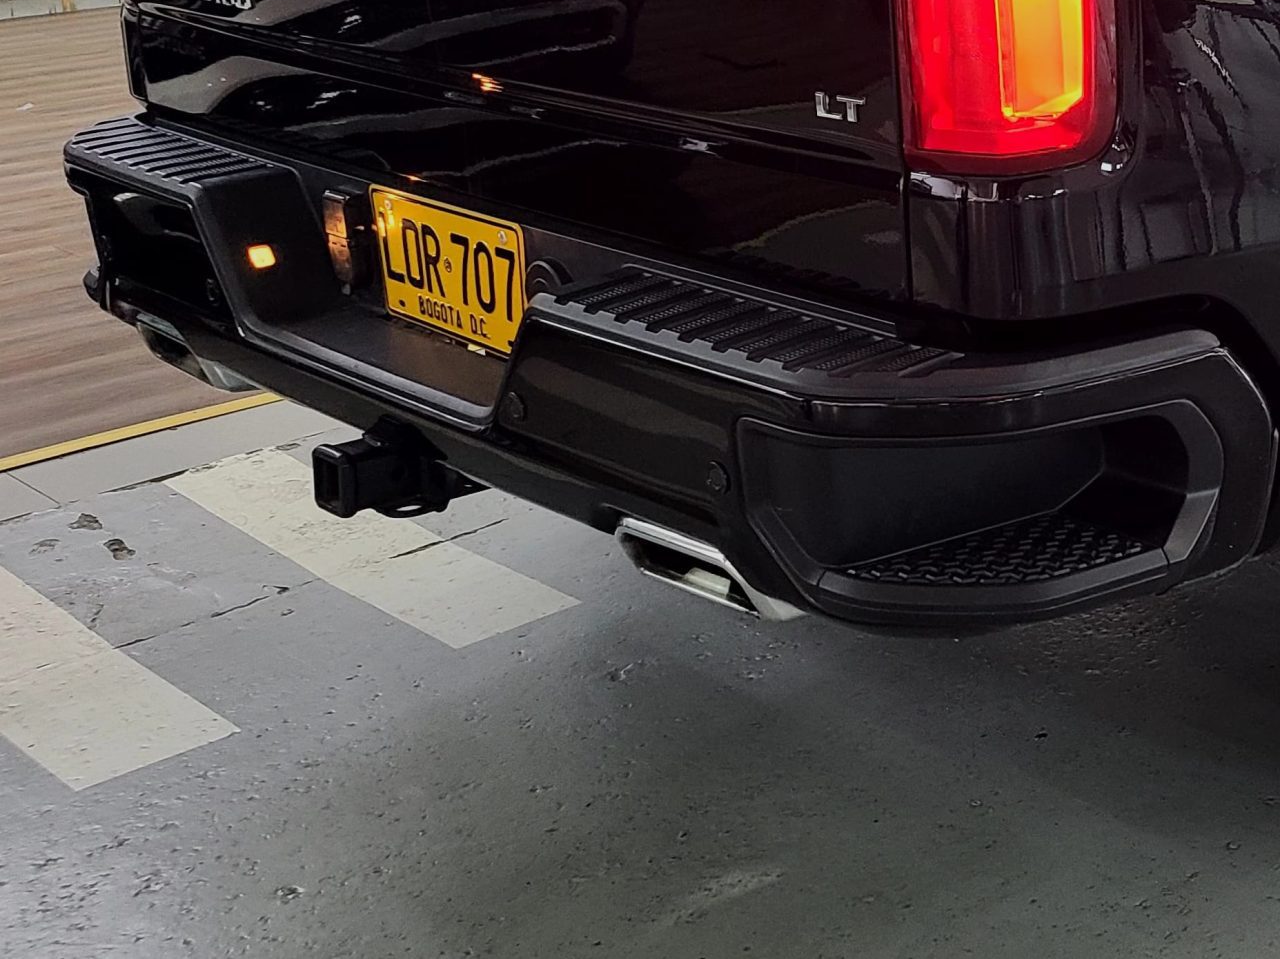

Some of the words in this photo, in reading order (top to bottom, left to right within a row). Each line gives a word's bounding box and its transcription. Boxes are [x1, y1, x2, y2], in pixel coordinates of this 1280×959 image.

[814, 91, 866, 123] LT
[450, 232, 516, 323] 707
[418, 295, 464, 330] BOGOTA
